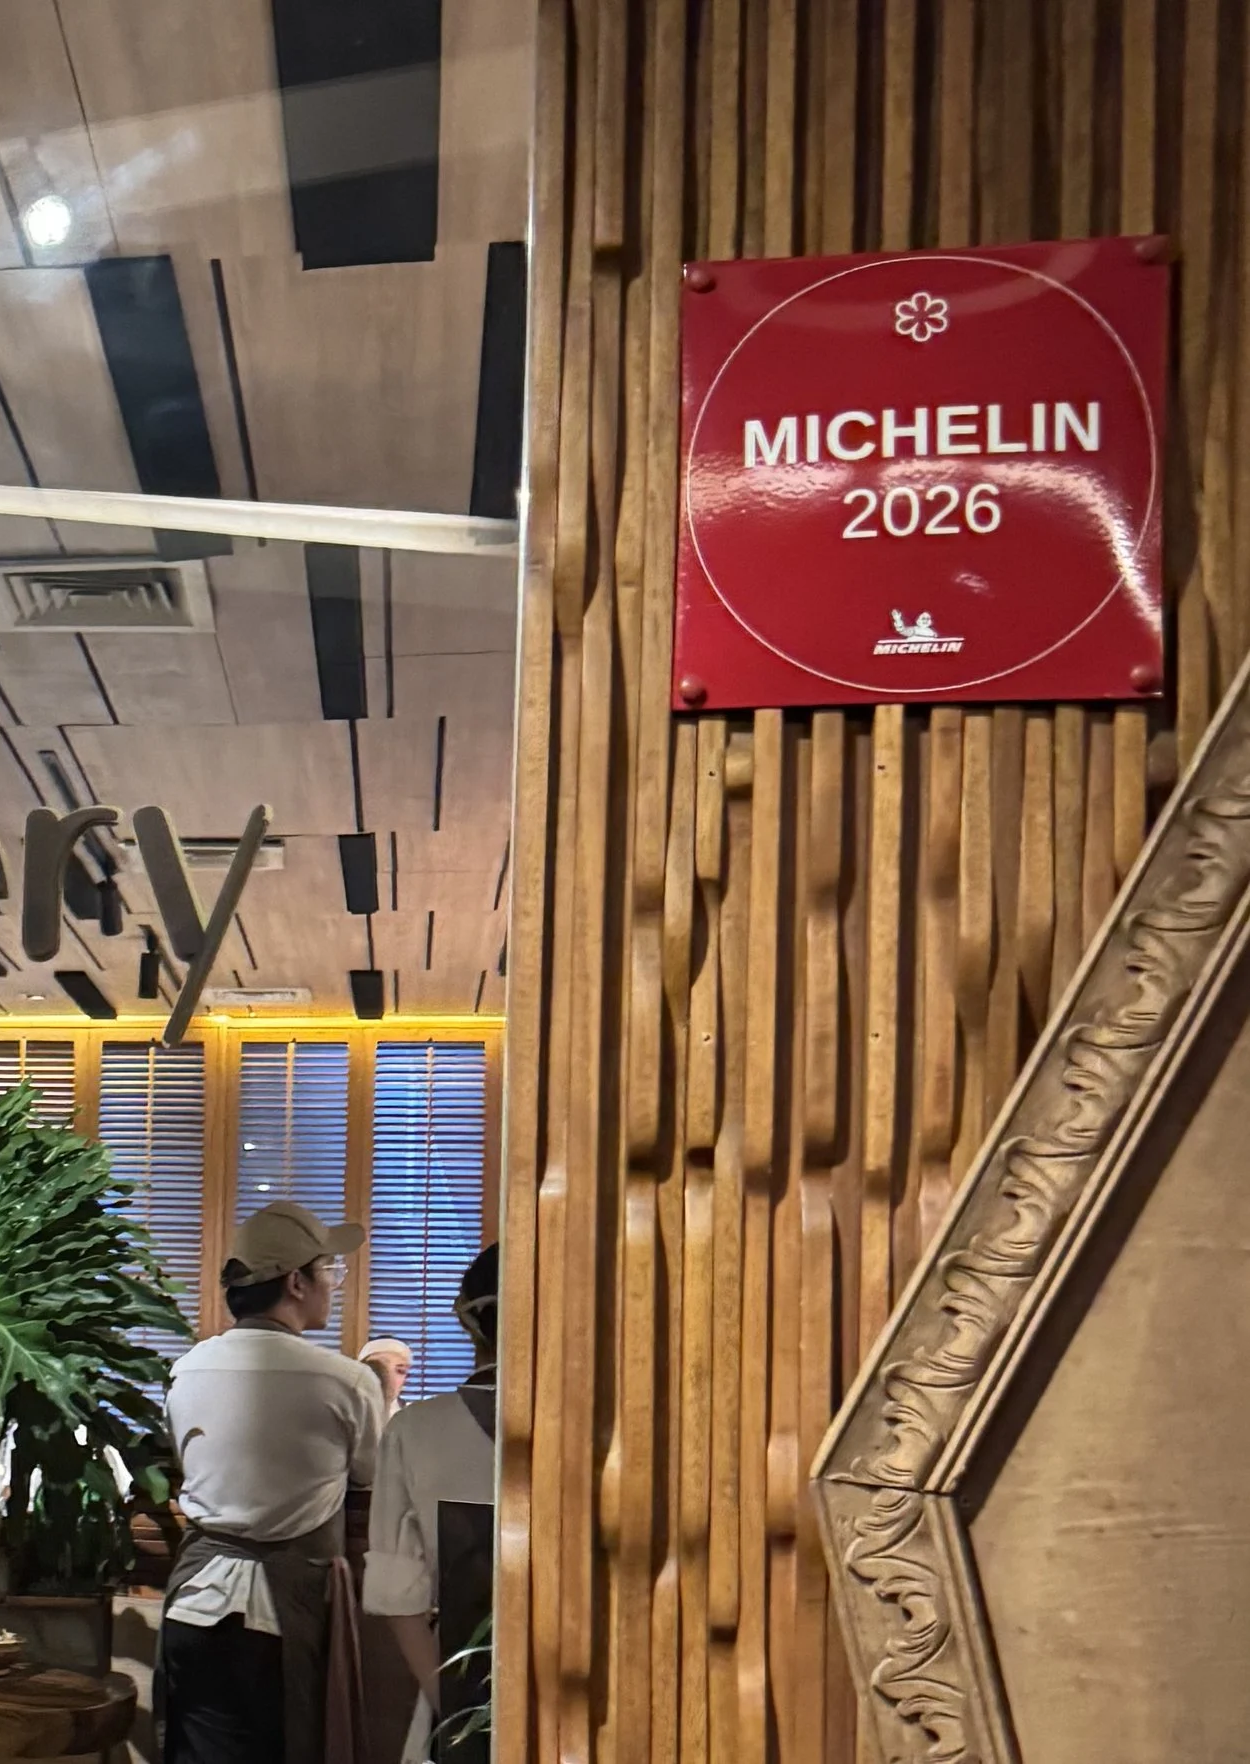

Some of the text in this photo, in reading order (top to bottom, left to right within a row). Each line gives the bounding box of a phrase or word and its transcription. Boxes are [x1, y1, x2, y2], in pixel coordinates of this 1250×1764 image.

[743, 401, 1101, 469] MICHELIN
[842, 483, 1002, 539] 2026
[872, 641, 964, 656] MICHELIN
